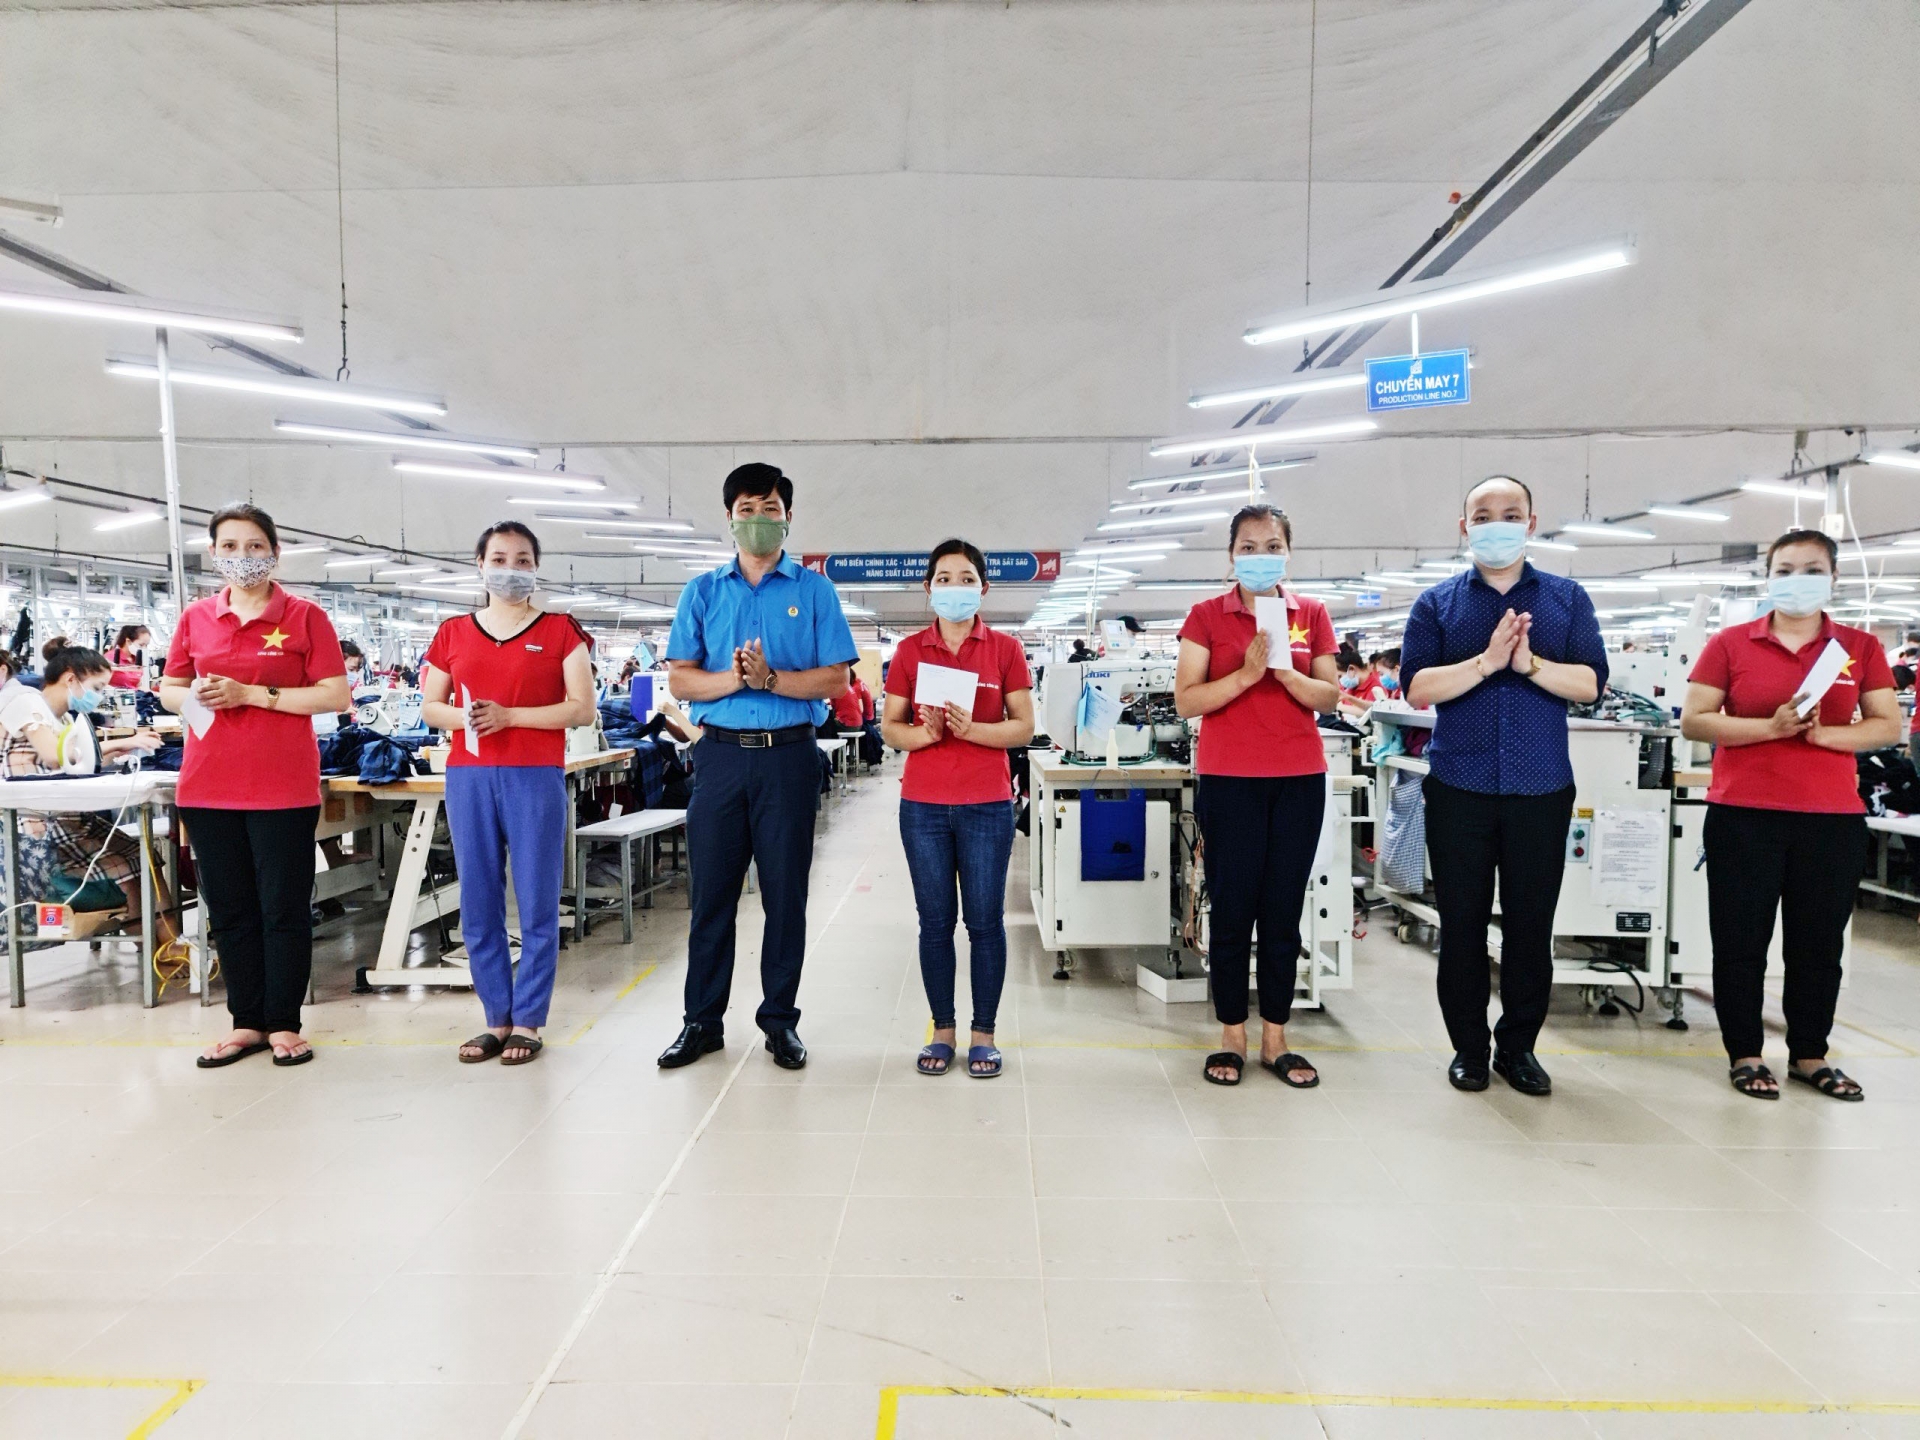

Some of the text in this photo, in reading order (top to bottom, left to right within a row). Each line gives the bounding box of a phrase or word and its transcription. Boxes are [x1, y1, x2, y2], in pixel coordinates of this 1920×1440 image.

[1375, 374, 1460, 394] CHUYẾN MAY 7
[1378, 390, 1457, 404] PRODUCTION LINE NO.7
[886, 557, 897, 567] XÁC
[903, 557, 917, 567] LÀM
[989, 558, 1001, 566] TRA
[1002, 557, 1014, 566] SÁT
[1016, 558, 1028, 566] SAO
[885, 568, 901, 577] SUẤT
[902, 568, 914, 577] LÊN
[988, 567, 1001, 577] BẢO
